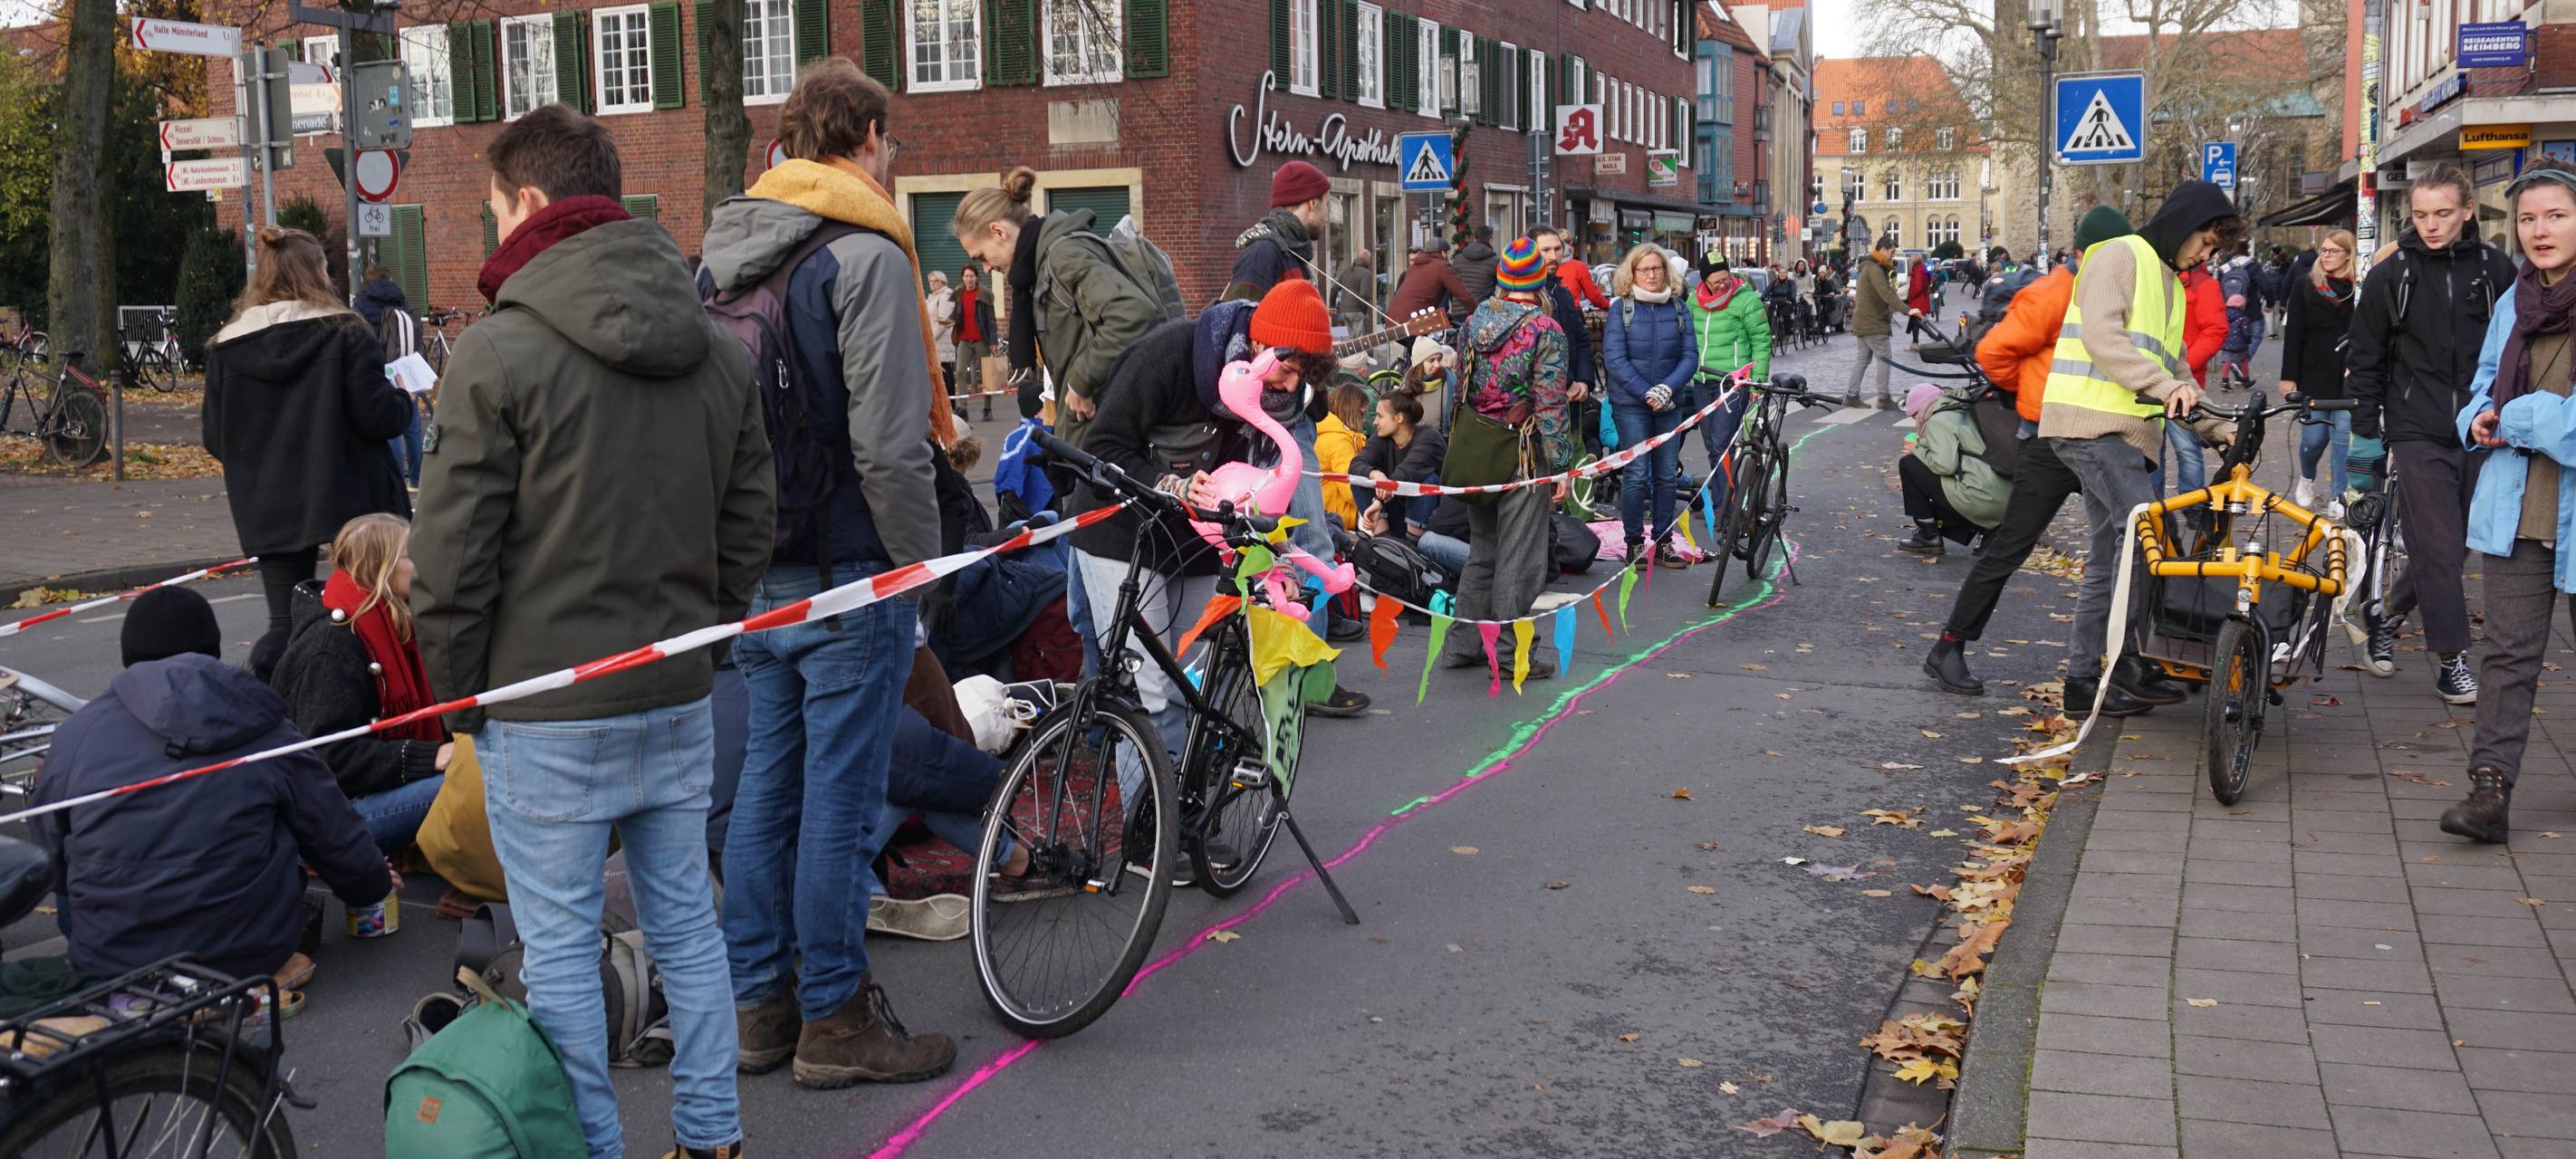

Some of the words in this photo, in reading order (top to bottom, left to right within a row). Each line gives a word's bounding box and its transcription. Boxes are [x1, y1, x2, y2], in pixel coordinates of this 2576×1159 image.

[153, 24, 169, 34] Halle
[171, 26, 208, 38] Münsterland
[2463, 36, 2521, 44] REISEAGENTUR
[2463, 42, 2521, 53] MEIMBERG
[1230, 69, 1401, 172] Stern-Apothek
[175, 125, 192, 133] Roxel
[175, 137, 201, 145] Universität
[207, 135, 226, 143] Schloss
[2464, 131, 2528, 143] Lufthansa
[2208, 146, 2223, 165] P
[181, 177, 227, 187] LWL-Landesmuseum
[369, 225, 380, 233] frei
[1593, 233, 1612, 242] Tee
